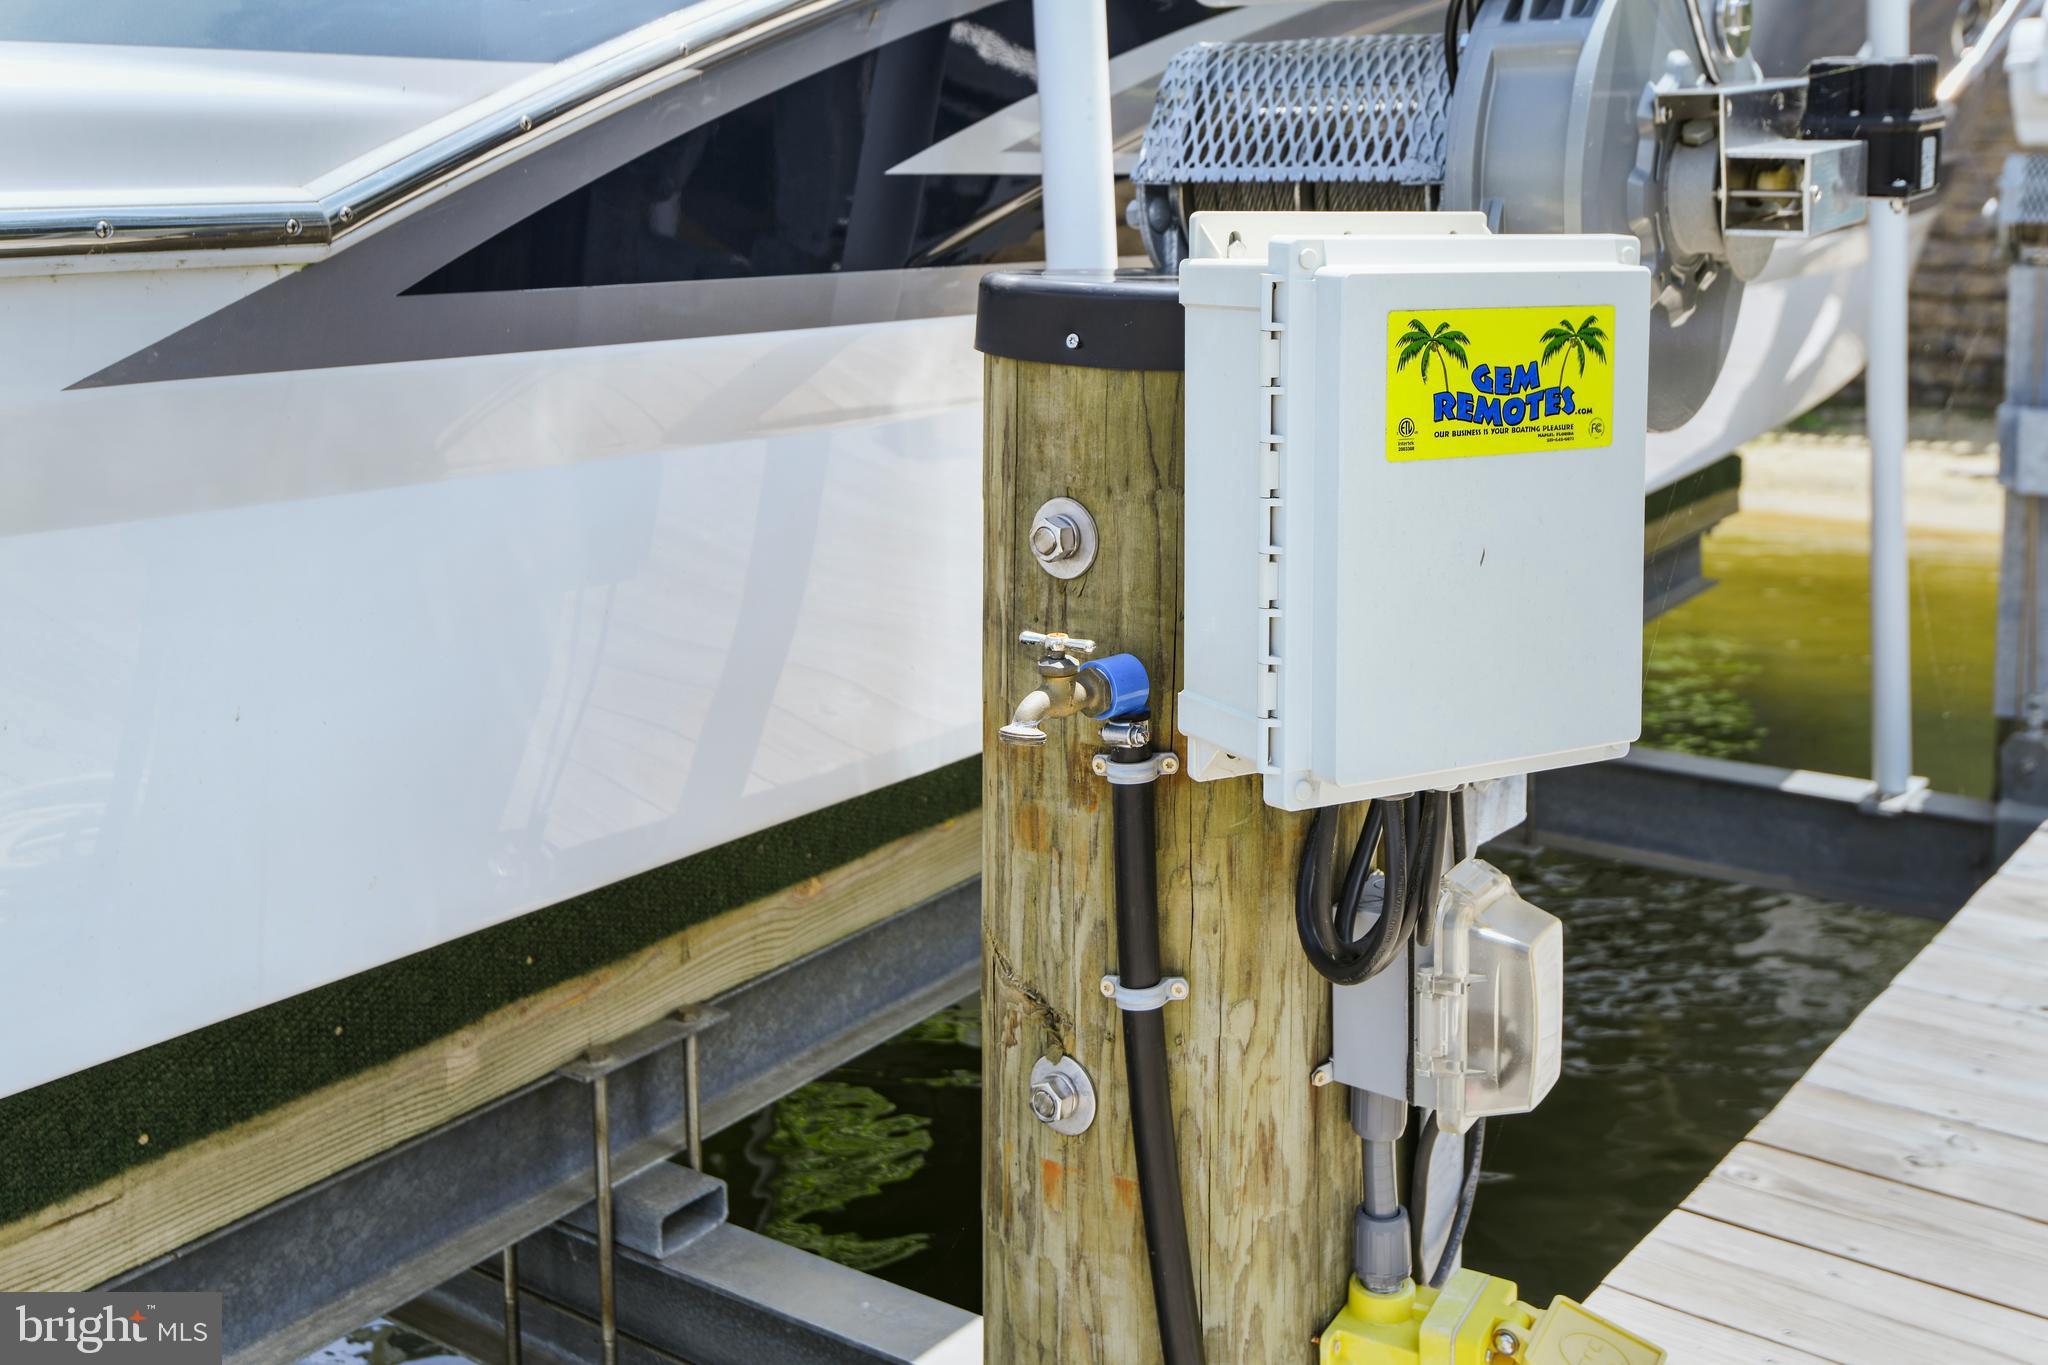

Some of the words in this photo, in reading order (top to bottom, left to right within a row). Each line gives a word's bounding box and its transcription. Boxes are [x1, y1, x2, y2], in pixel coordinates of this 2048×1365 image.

[1471, 361, 1541, 395] GEM
[1433, 385, 1576, 427] REMOTES
[1491, 427, 1509, 435] YOUR
[1512, 425, 1540, 433] BOATING
